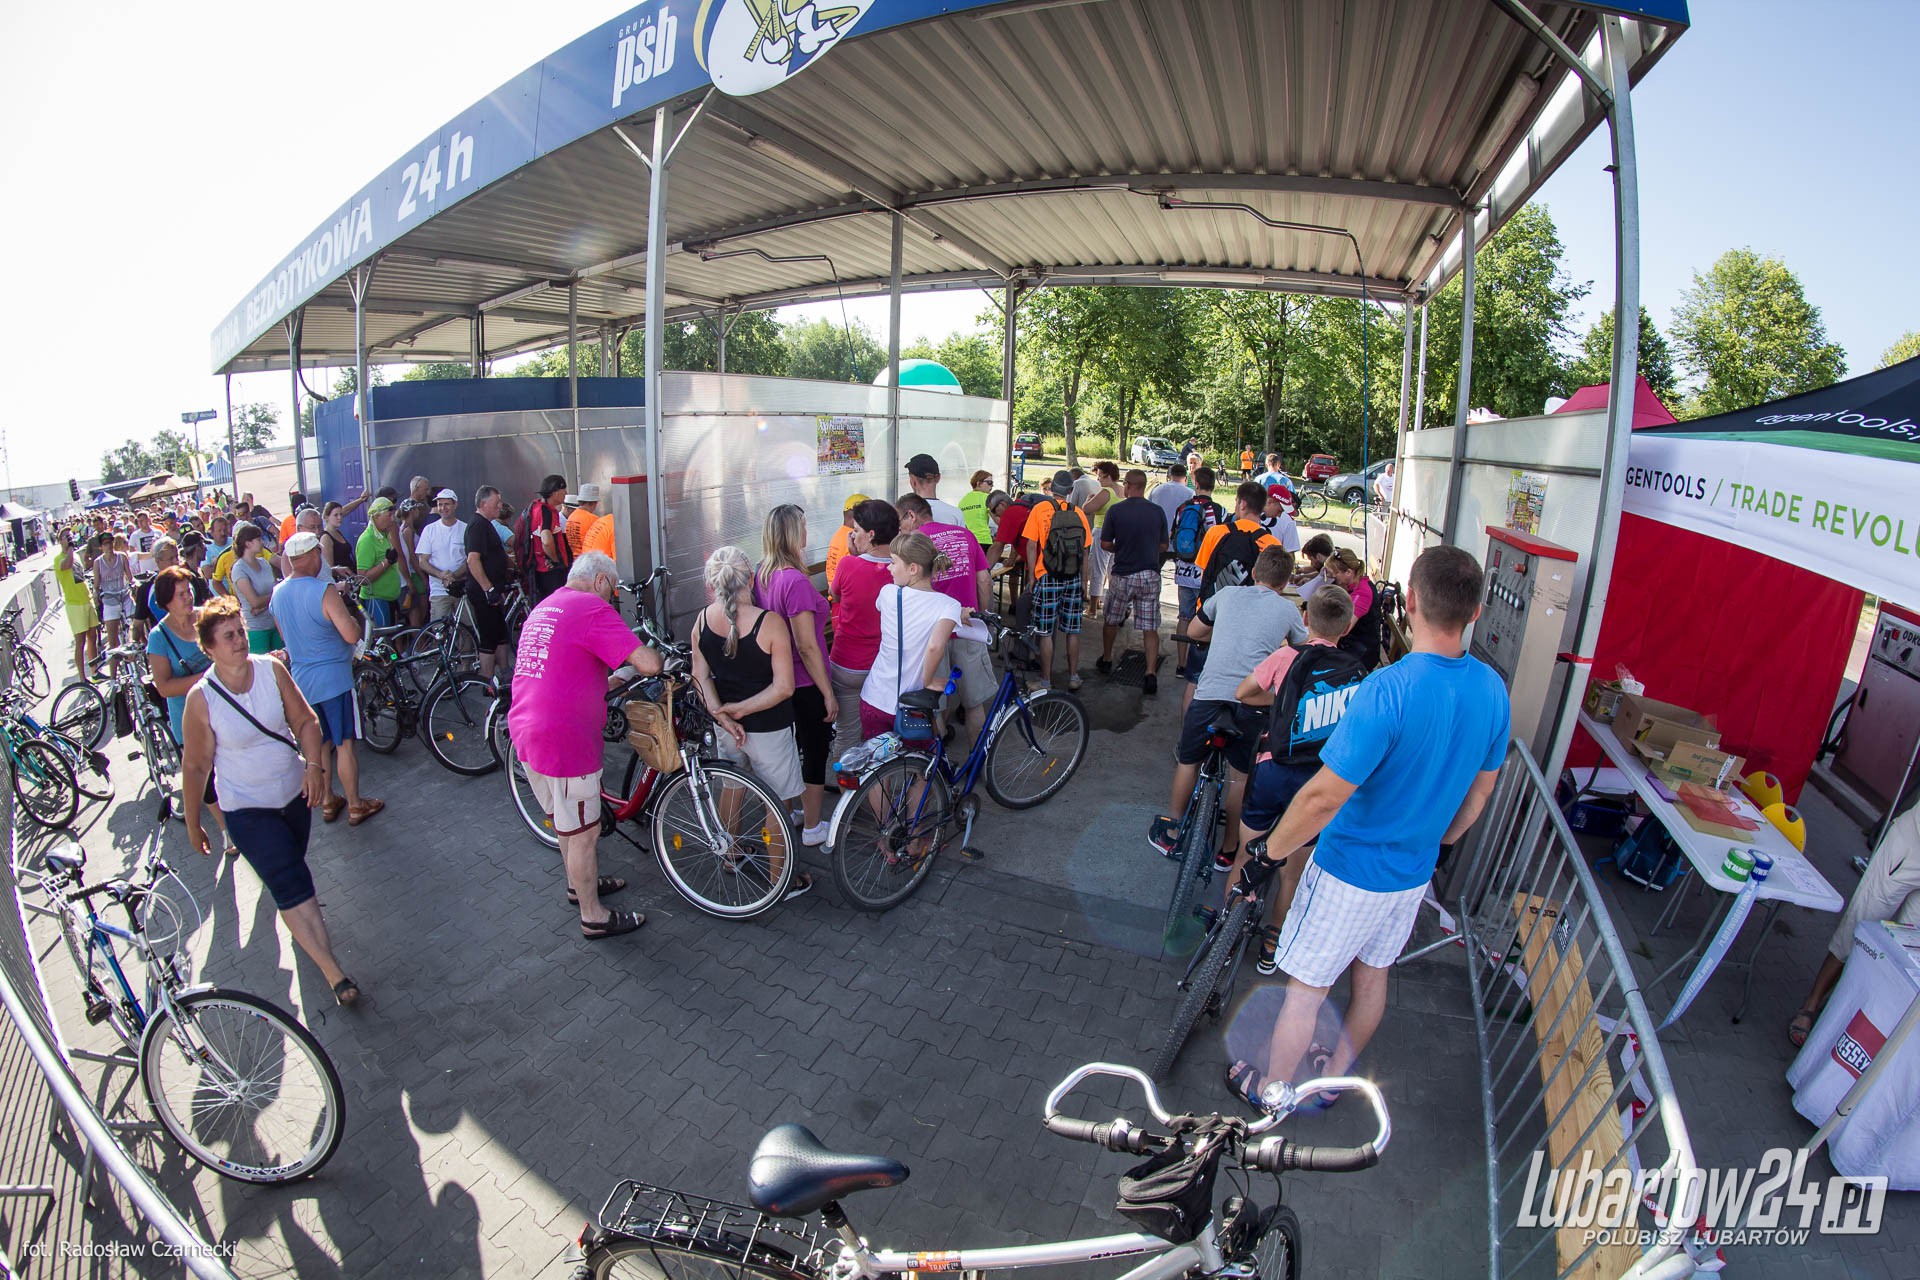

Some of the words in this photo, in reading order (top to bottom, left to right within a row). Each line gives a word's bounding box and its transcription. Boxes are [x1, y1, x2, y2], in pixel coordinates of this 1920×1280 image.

[612, 6, 678, 109] psb
[619, 15, 651, 38] GRUPA
[246, 197, 374, 337] BEZDOTYKOWA
[1755, 409, 1920, 440] agentools.
[1625, 467, 1706, 500] GENTOOLS
[1731, 483, 1803, 523] TRADE
[1812, 500, 1920, 560] REVOL
